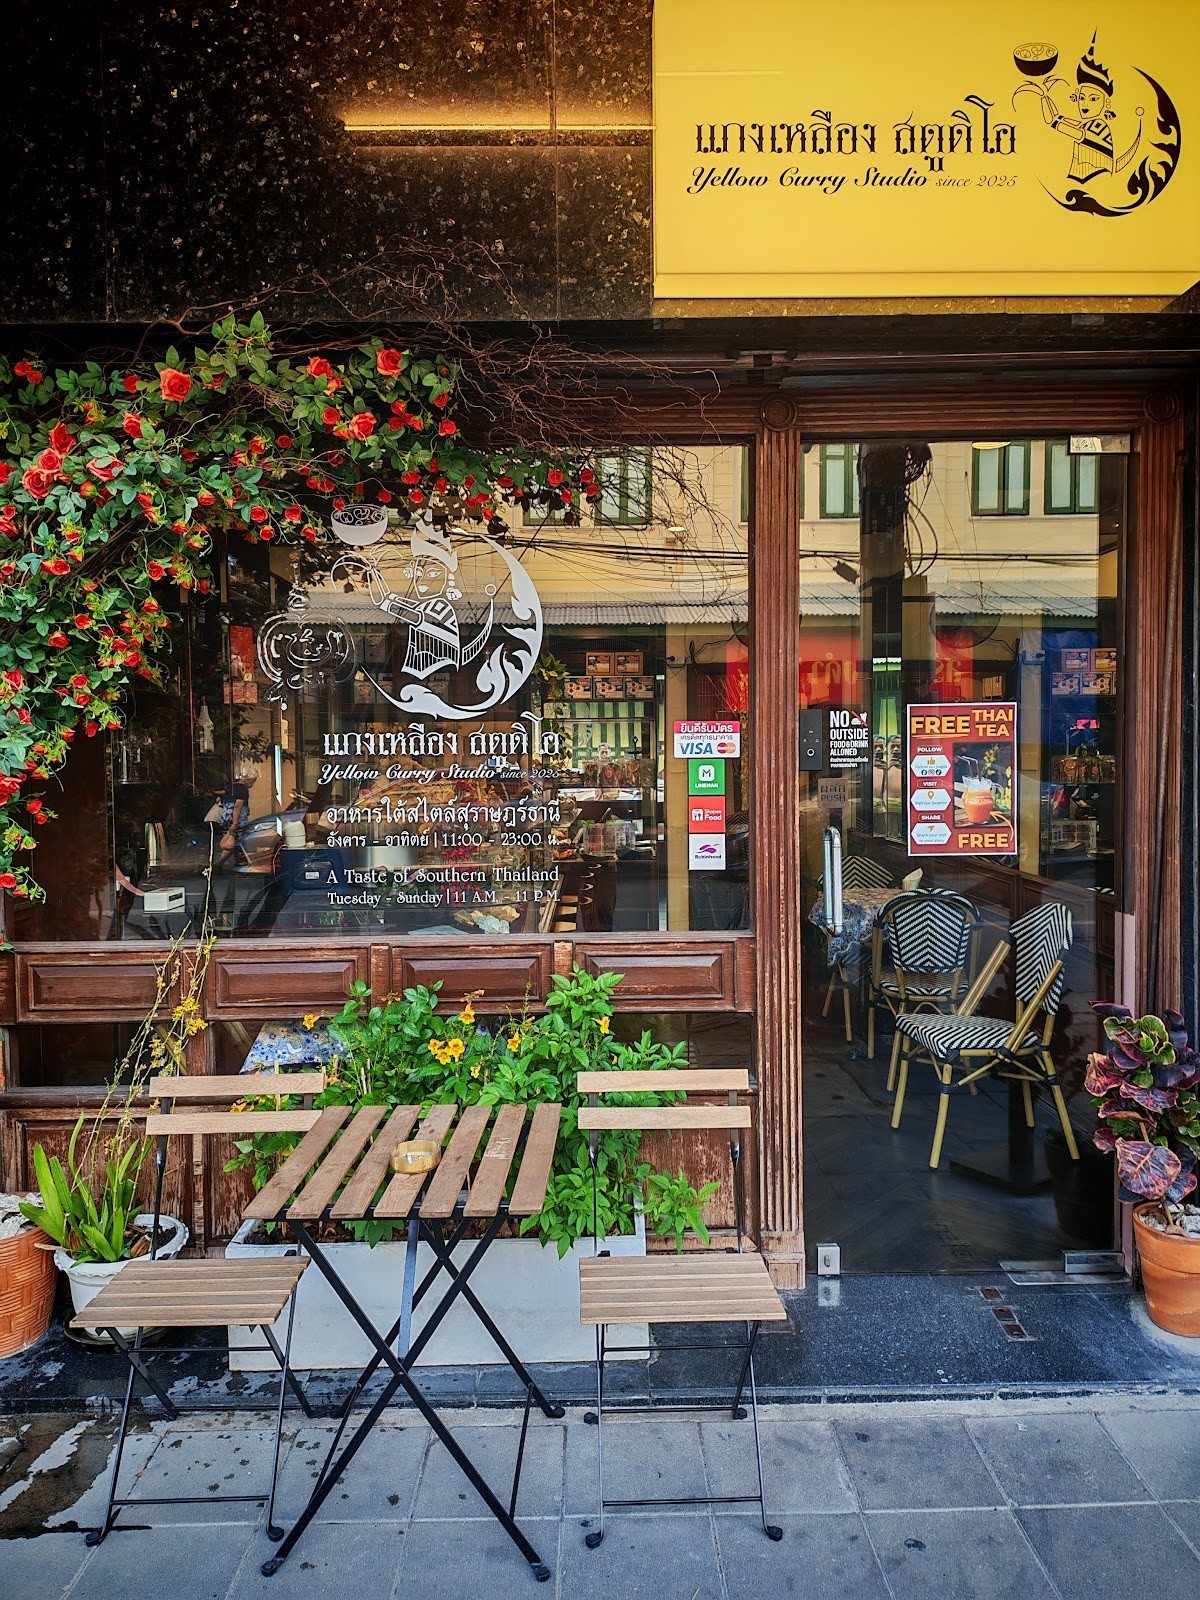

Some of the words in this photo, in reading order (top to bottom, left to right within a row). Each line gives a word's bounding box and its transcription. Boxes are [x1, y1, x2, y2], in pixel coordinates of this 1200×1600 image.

[694, 110, 877, 154] แกงเหลือง
[893, 94, 1017, 173] สตูดิโอ
[687, 166, 772, 195] Yellow
[779, 166, 849, 195] Curry
[854, 165, 932, 188] Studio
[935, 172, 972, 188] since
[975, 174, 1018, 188] 2025
[829, 710, 850, 728] NO
[971, 708, 1014, 722] THAI
[680, 722, 734, 733] ยินดีรับบัตร
[910, 714, 971, 735] FREE
[975, 723, 1010, 737] TEA
[322, 722, 459, 756] แกงเหลือง
[468, 711, 561, 768] สตูดิโอ
[829, 728, 869, 740] OUTSIDE
[677, 742, 713, 755] VISA
[829, 748, 858, 756] ALLOWED
[317, 763, 381, 785] Yellow
[386, 763, 437, 785] Curry
[440, 762, 498, 779] Studio
[500, 769, 528, 779] since
[529, 768, 561, 778] 2025
[820, 782, 846, 793] ผลัก
[820, 794, 846, 802] PUSH
[326, 796, 561, 831] อาหารใต้สไตล์สุราษฎร์ธานี
[704, 808, 723, 816] Shopee
[326, 830, 367, 848] อังคาร
[385, 827, 430, 848] อาทิตย์
[442, 831, 483, 847] 11:00
[501, 832, 542, 847] 23:00
[547, 832, 560, 847] น.
[957, 833, 1009, 849] FREE
[326, 869, 339, 884] A
[343, 868, 388, 884] Taste
[393, 866, 411, 883] of
[415, 866, 487, 883] Southern
[493, 864, 560, 882] Thailand
[327, 889, 383, 908] Tuesday
[396, 889, 444, 908] Sunday
[454, 891, 467, 903] 11
[472, 890, 499, 903] A.M.
[515, 890, 528, 902] 11
[533, 889, 561, 902] PM.
